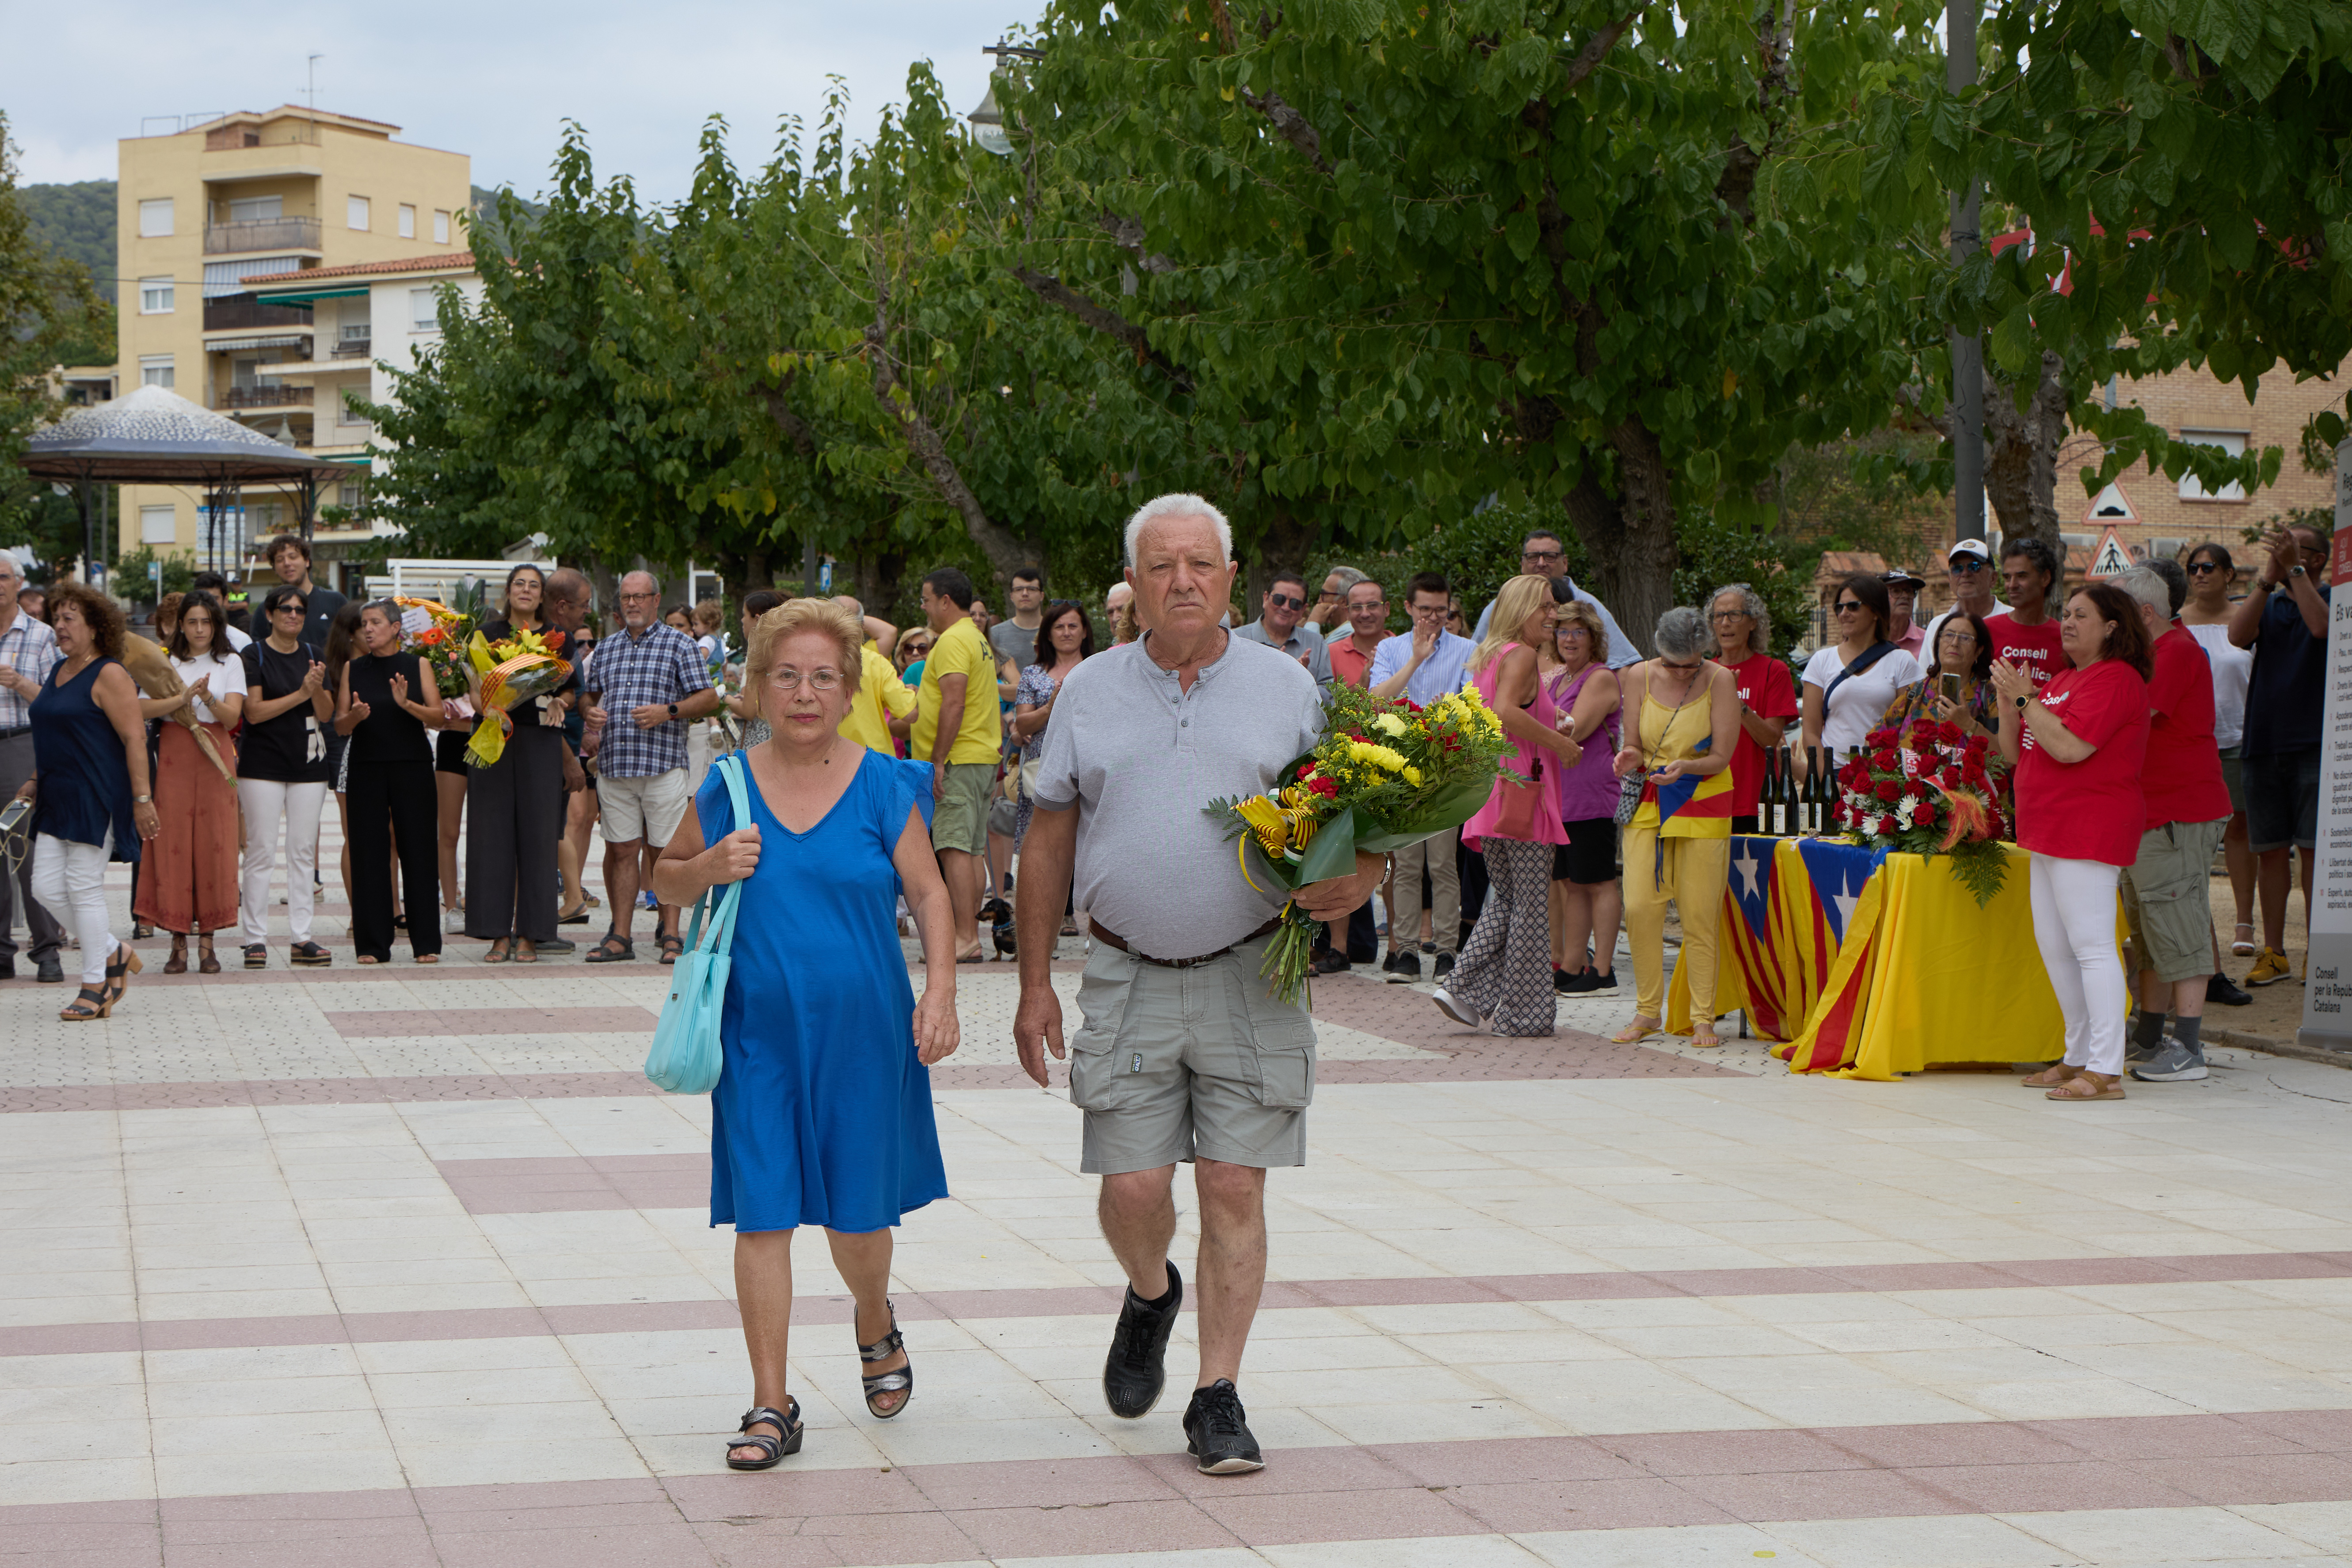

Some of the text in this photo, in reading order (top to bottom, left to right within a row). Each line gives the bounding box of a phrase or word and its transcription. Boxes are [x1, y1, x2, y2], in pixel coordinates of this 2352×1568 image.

[823, 566, 829, 588] P
[2002, 646, 2047, 660] Consell
[2316, 966, 2338, 980] Consell
[2314, 986, 2325, 998] per
[2326, 983, 2331, 996] la
[2314, 999, 2341, 1013] Catalana
